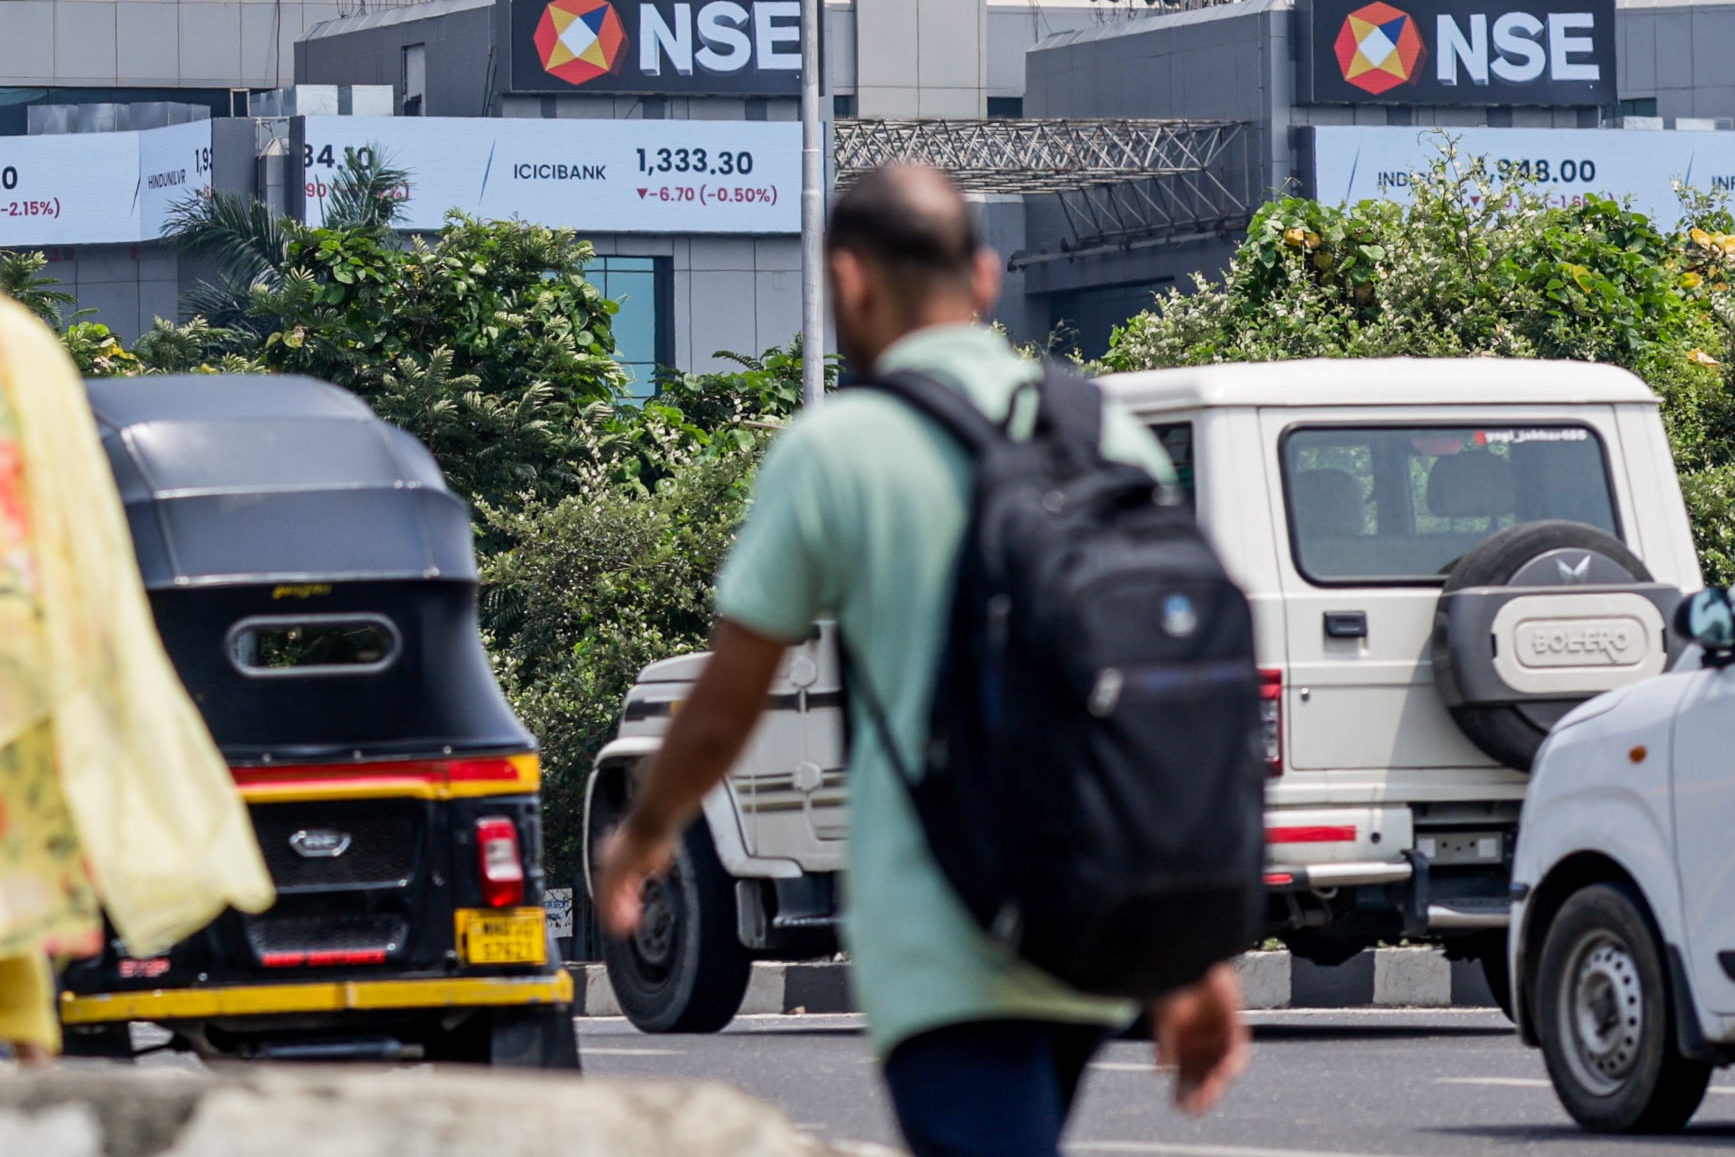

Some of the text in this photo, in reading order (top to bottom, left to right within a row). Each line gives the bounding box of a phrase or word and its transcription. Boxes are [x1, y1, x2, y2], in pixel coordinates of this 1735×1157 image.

[639, 0, 802, 78] NSE
[1436, 11, 1600, 87] NSE
[514, 163, 607, 180] ICICIBANK
[636, 148, 753, 176] 1,333.30
[649, 184, 778, 205] -6.70 (-0.50%)
[1532, 630, 1629, 664] BOLERO
